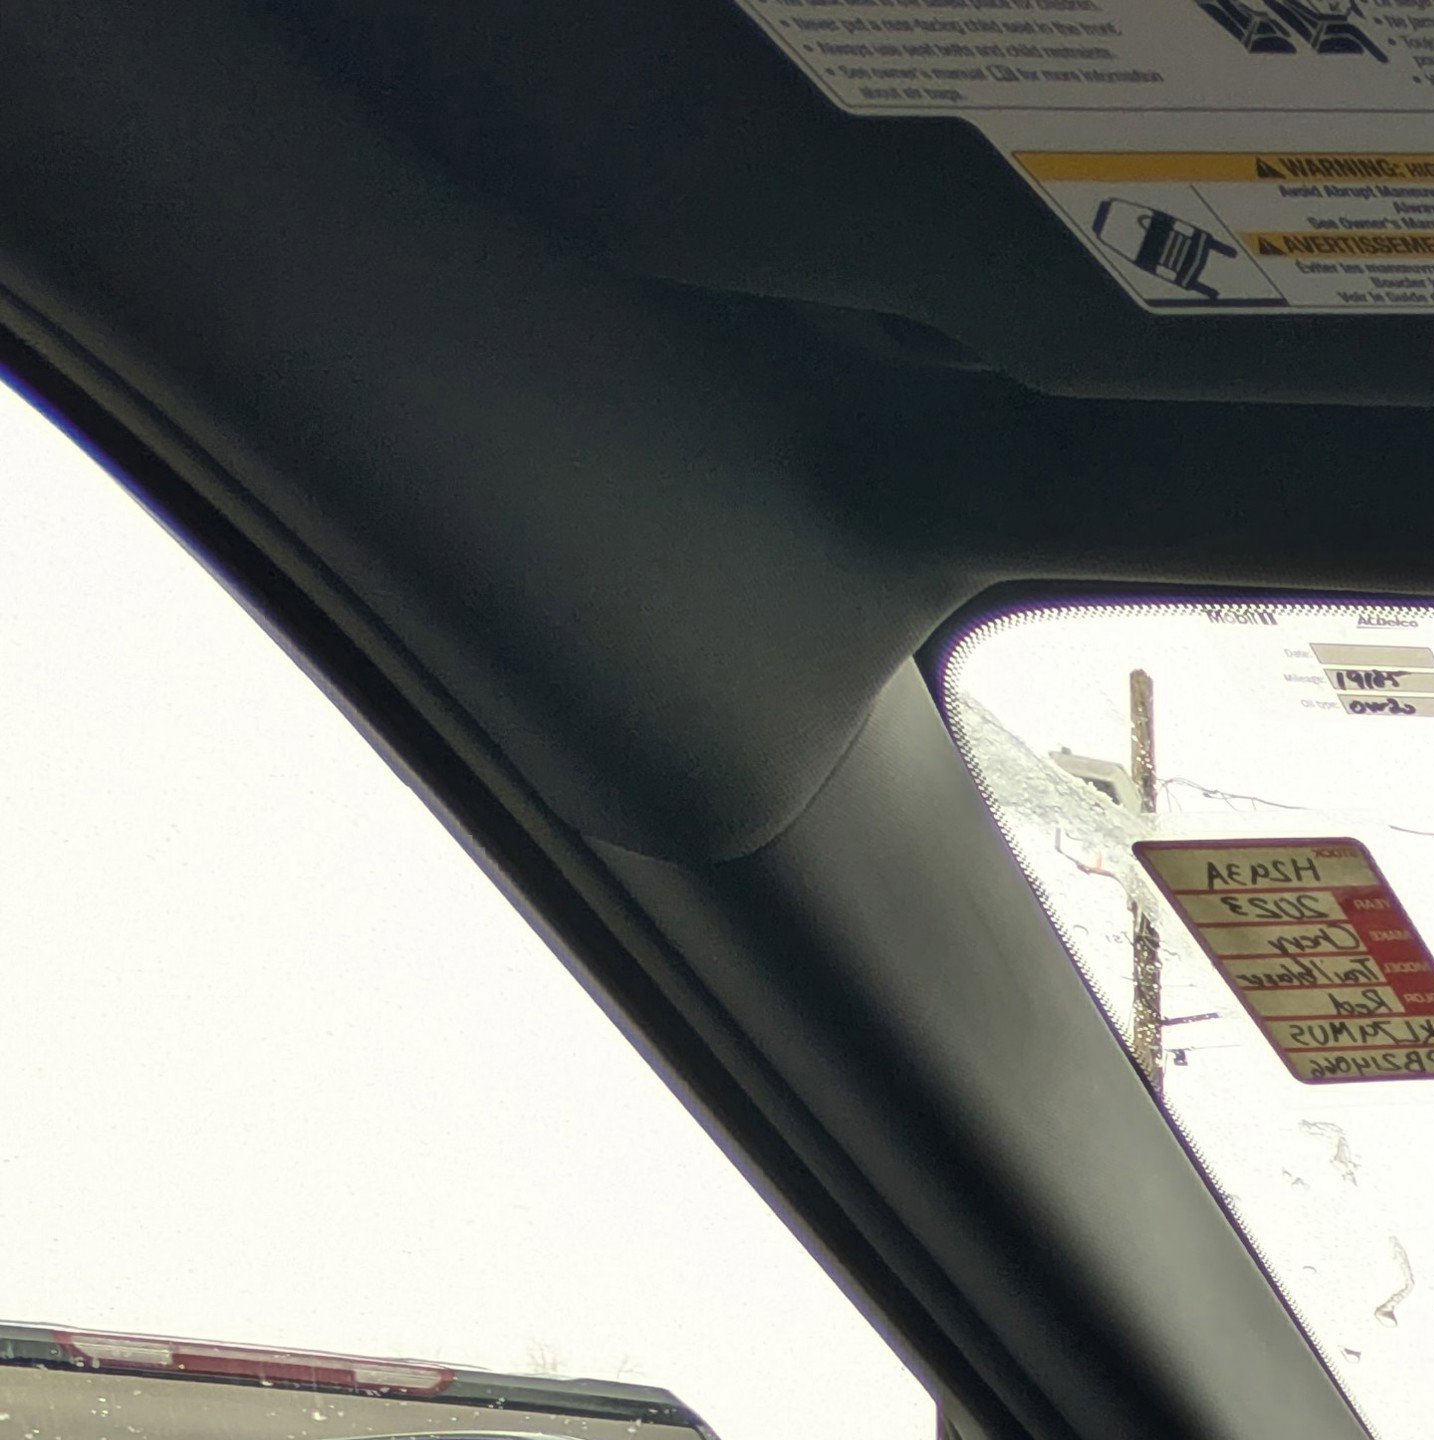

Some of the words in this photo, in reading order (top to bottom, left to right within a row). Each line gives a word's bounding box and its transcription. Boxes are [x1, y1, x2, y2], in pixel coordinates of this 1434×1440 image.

[1278, 157, 1406, 178] WARNING:
[1278, 185, 1323, 198] Avoid
[1322, 185, 1378, 200] Abrupt
[1306, 217, 1340, 230] See
[1338, 217, 1402, 230] Owner's
